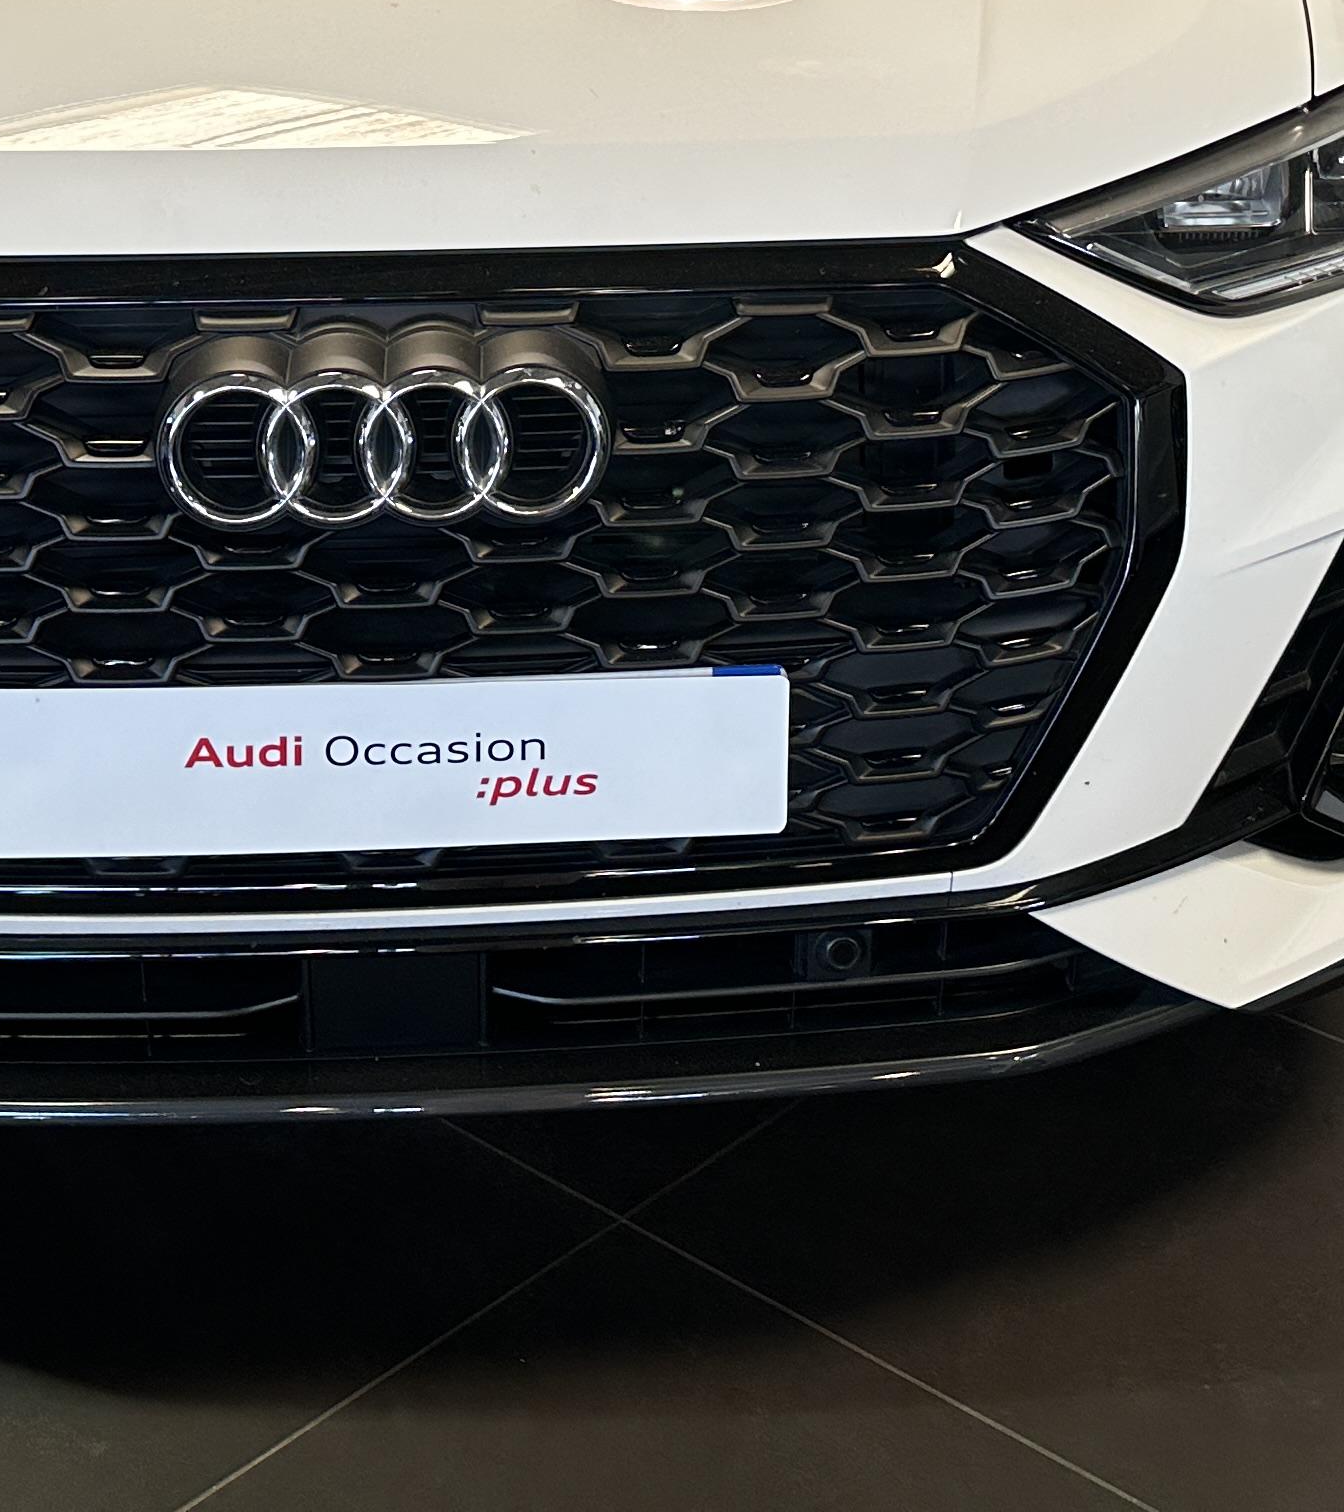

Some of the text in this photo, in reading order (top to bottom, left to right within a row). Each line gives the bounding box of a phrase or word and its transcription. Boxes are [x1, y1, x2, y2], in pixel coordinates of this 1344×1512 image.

[186, 733, 546, 768] Audi Occasion
[475, 768, 598, 805] :plus
